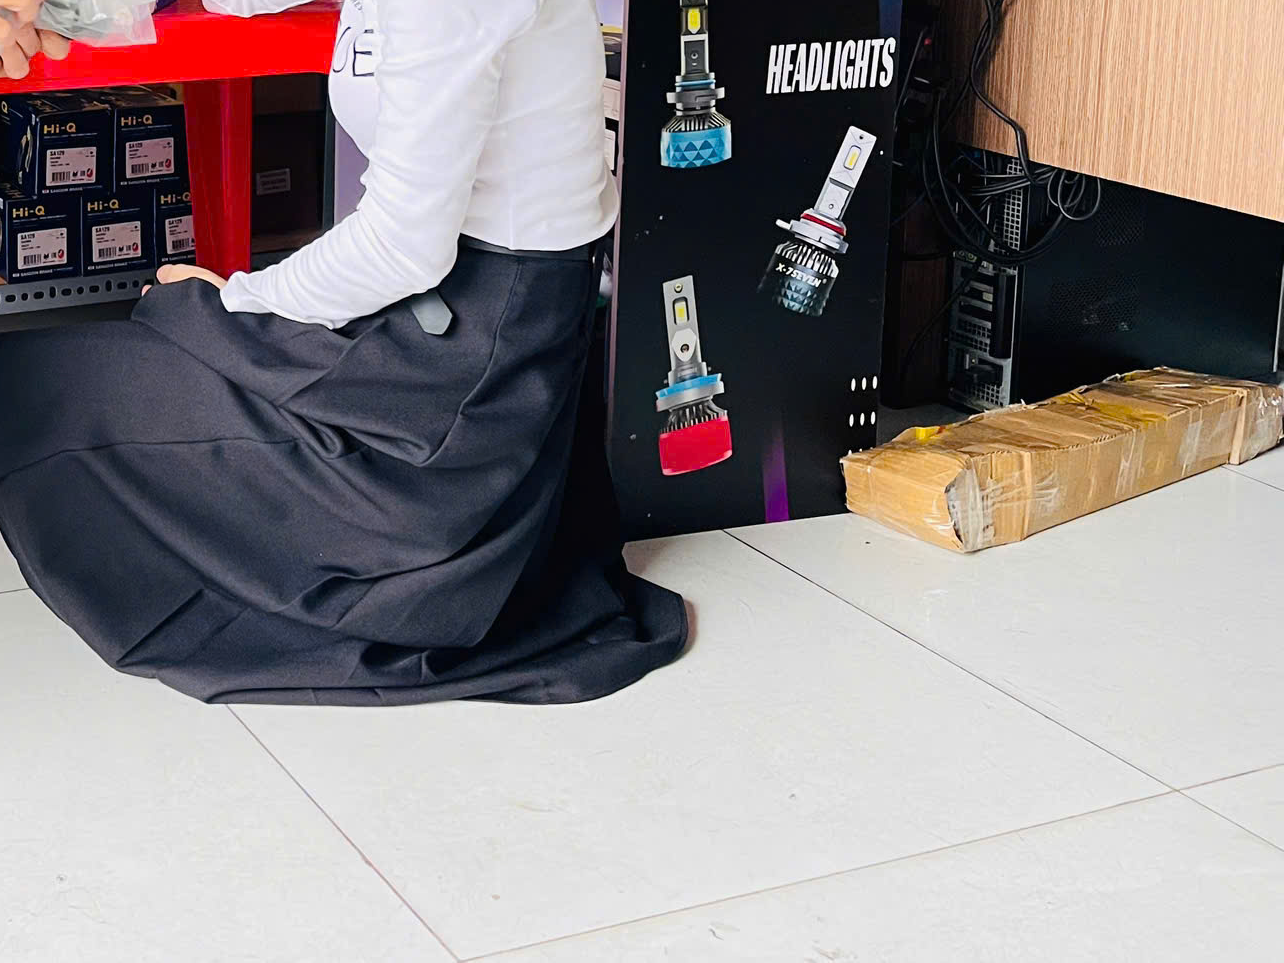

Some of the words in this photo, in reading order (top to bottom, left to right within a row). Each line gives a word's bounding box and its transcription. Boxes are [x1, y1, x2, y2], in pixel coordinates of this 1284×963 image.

[765, 37, 896, 95] HEADLIGHTS
[120, 114, 153, 126] Hi-Q
[43, 122, 77, 135] Hi-Q
[160, 191, 192, 205] Hi-Q
[12, 205, 46, 218] Hi-Q
[86, 199, 120, 212] Hi-Q
[775, 262, 821, 288] X-7SEVEN
